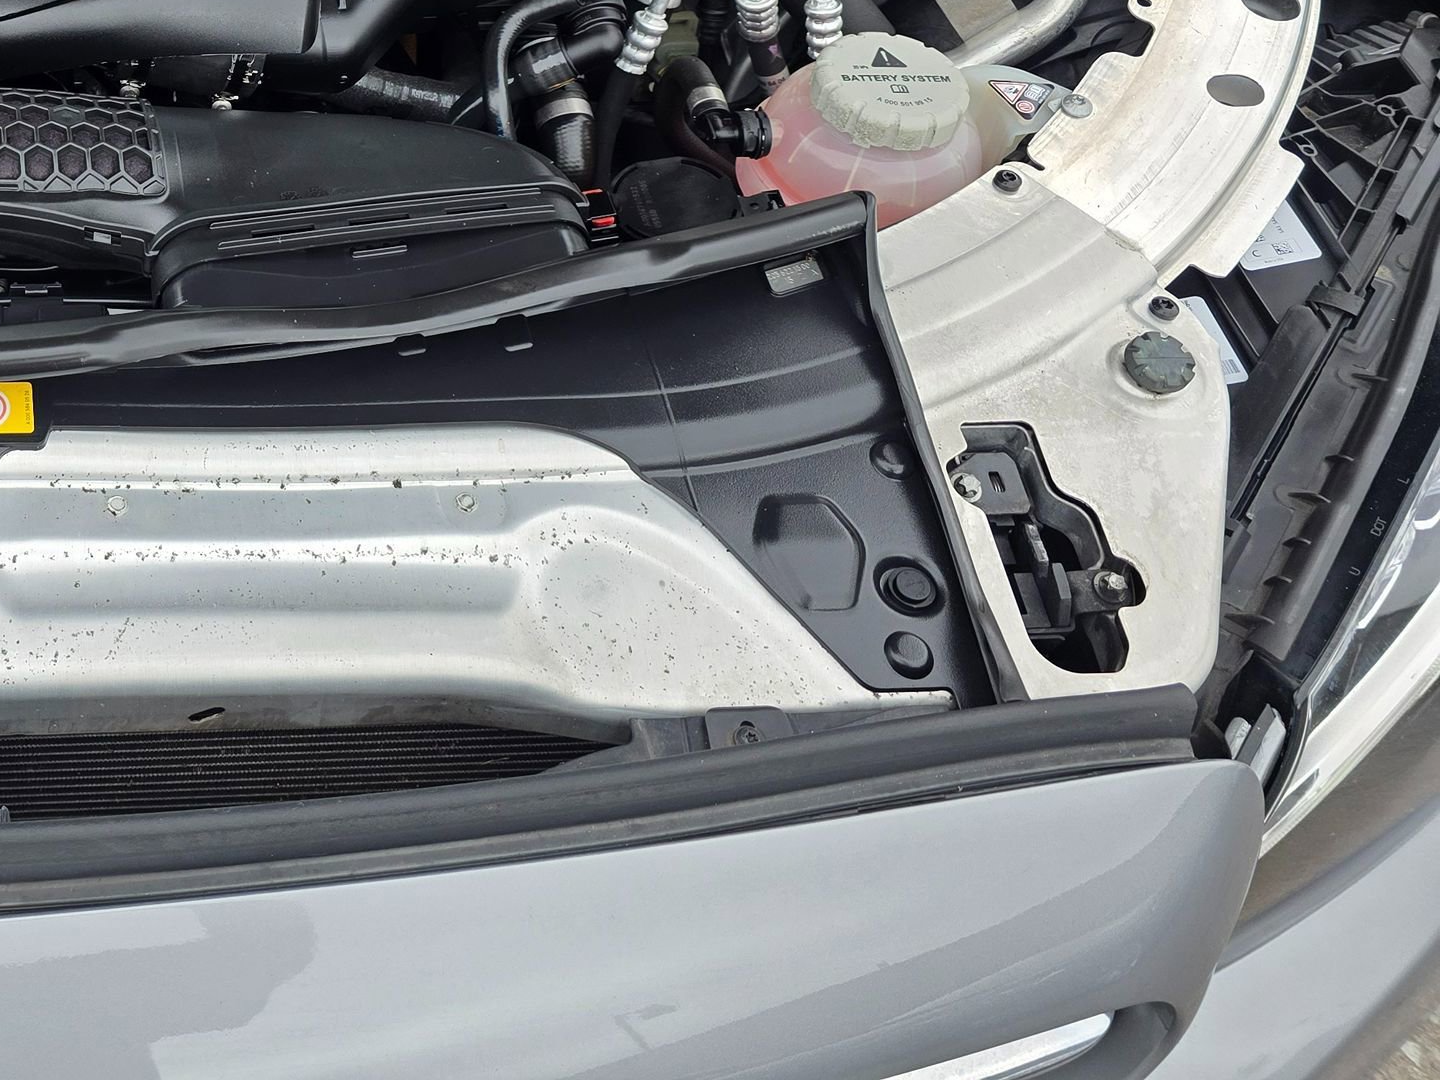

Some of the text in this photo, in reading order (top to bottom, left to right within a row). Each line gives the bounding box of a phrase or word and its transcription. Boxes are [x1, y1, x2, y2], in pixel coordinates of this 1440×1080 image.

[841, 74, 951, 83] BATTERY SYSTEM
[1370, 516, 1387, 537] DOT
